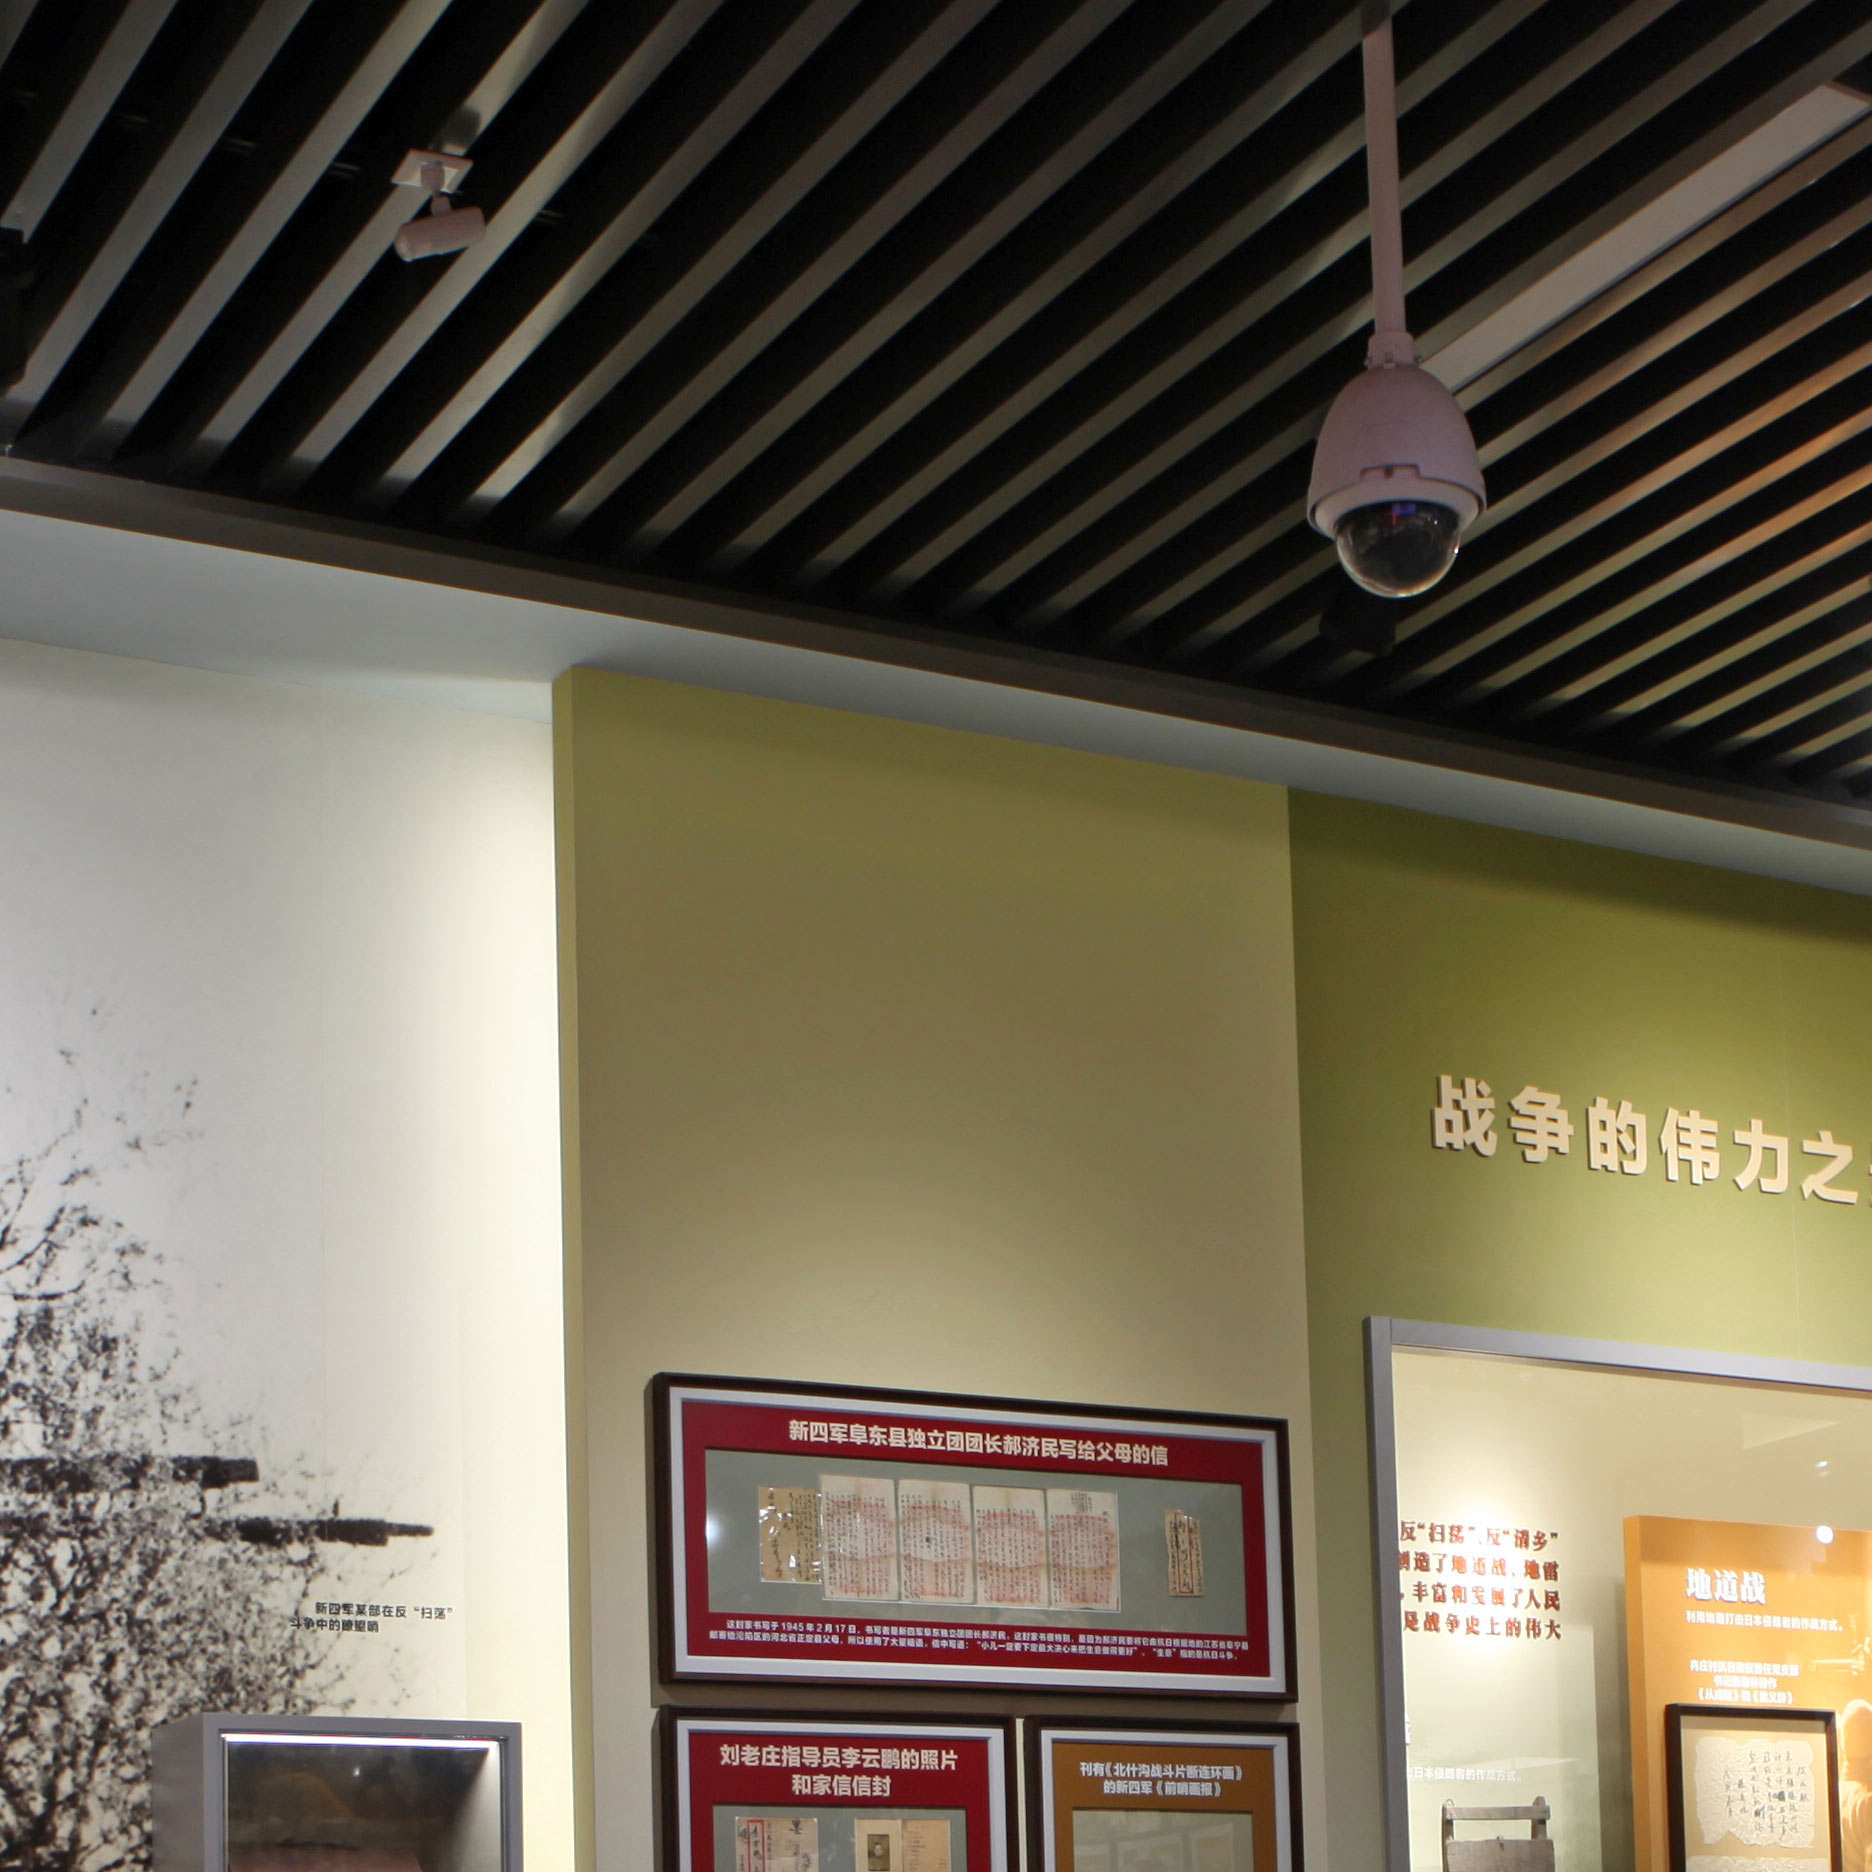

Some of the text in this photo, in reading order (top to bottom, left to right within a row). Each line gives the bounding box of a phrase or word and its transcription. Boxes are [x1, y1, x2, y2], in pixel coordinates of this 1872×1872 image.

[789, 1419, 1168, 1466] 新四军阜东县独立团团长郝济民写给父母的信
[1686, 1568, 1767, 1605] 地道战
[720, 1744, 958, 1770] 刘老庄指导员李云鹏的照片
[792, 1774, 891, 1797] 和家信信封
